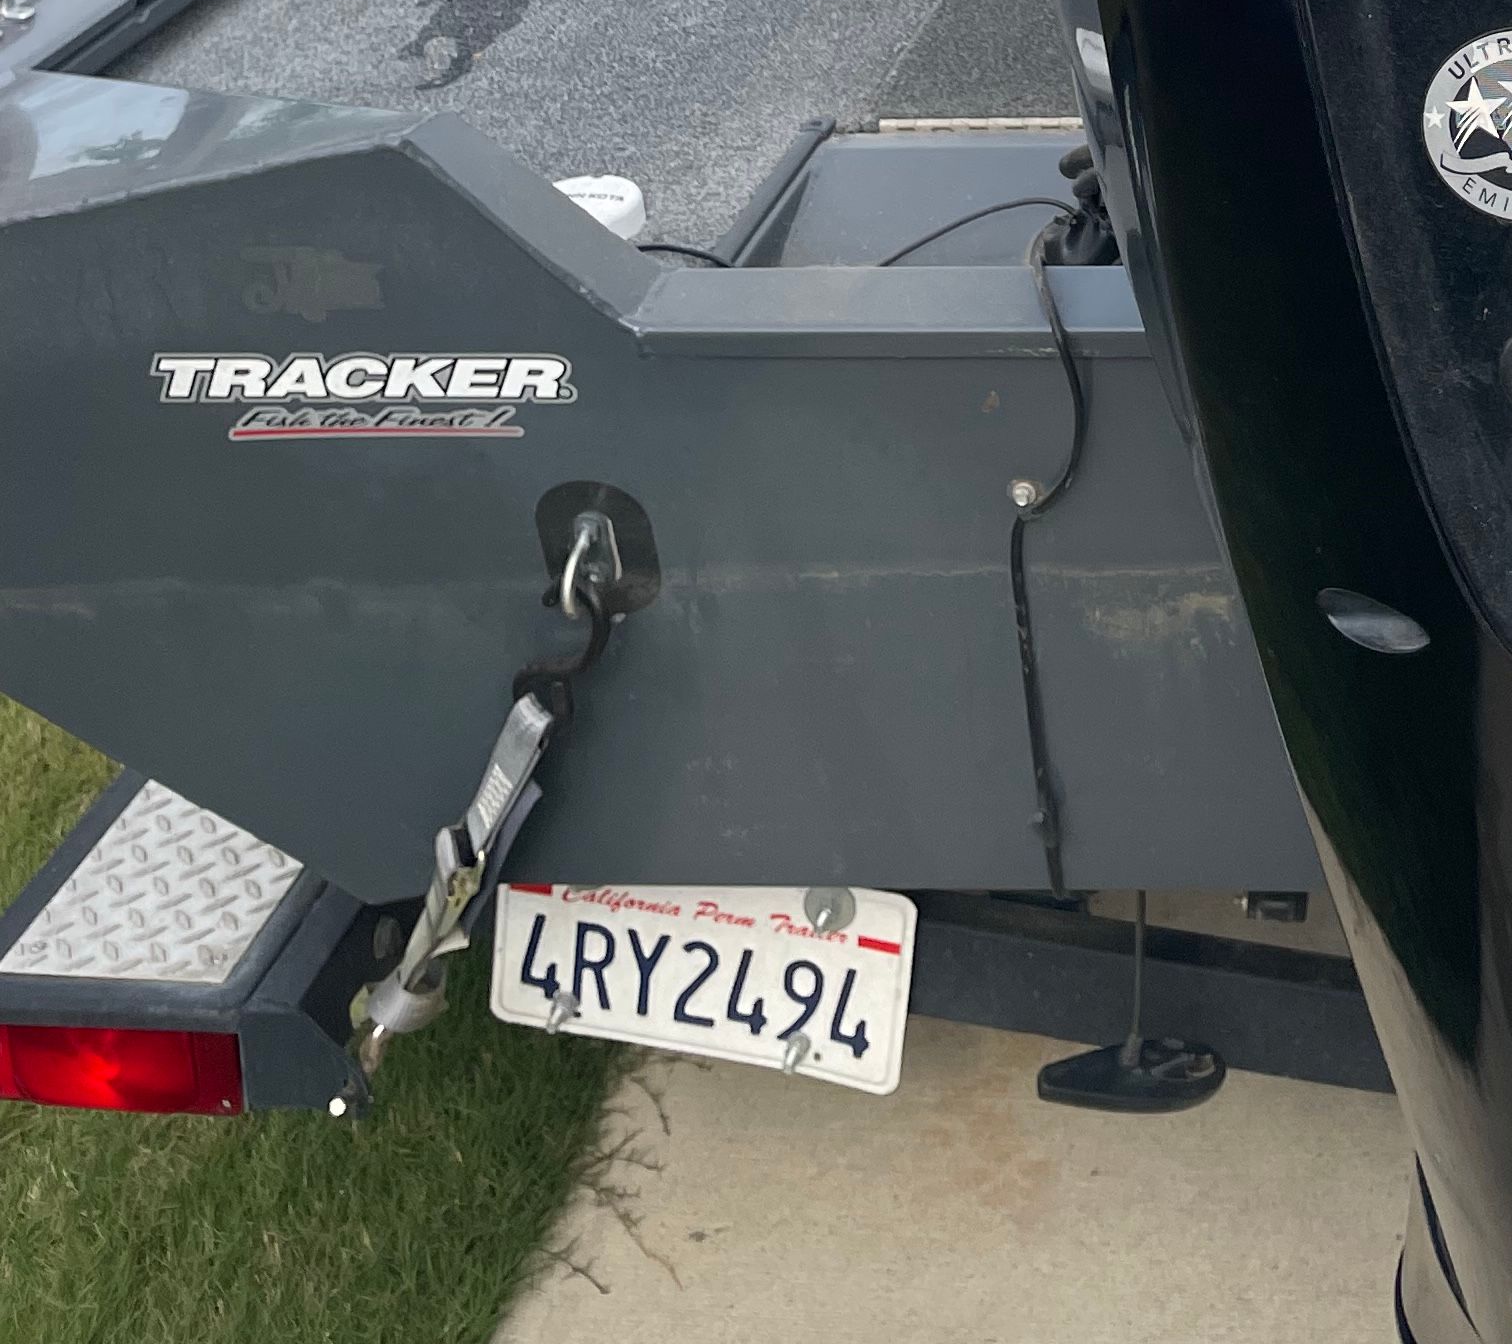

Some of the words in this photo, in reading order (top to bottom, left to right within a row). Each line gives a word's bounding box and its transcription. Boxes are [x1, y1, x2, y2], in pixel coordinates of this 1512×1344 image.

[156, 356, 570, 401] TRACKER
[318, 410, 367, 427] the
[561, 887, 681, 918] California
[519, 913, 871, 1060] 4RY2494
